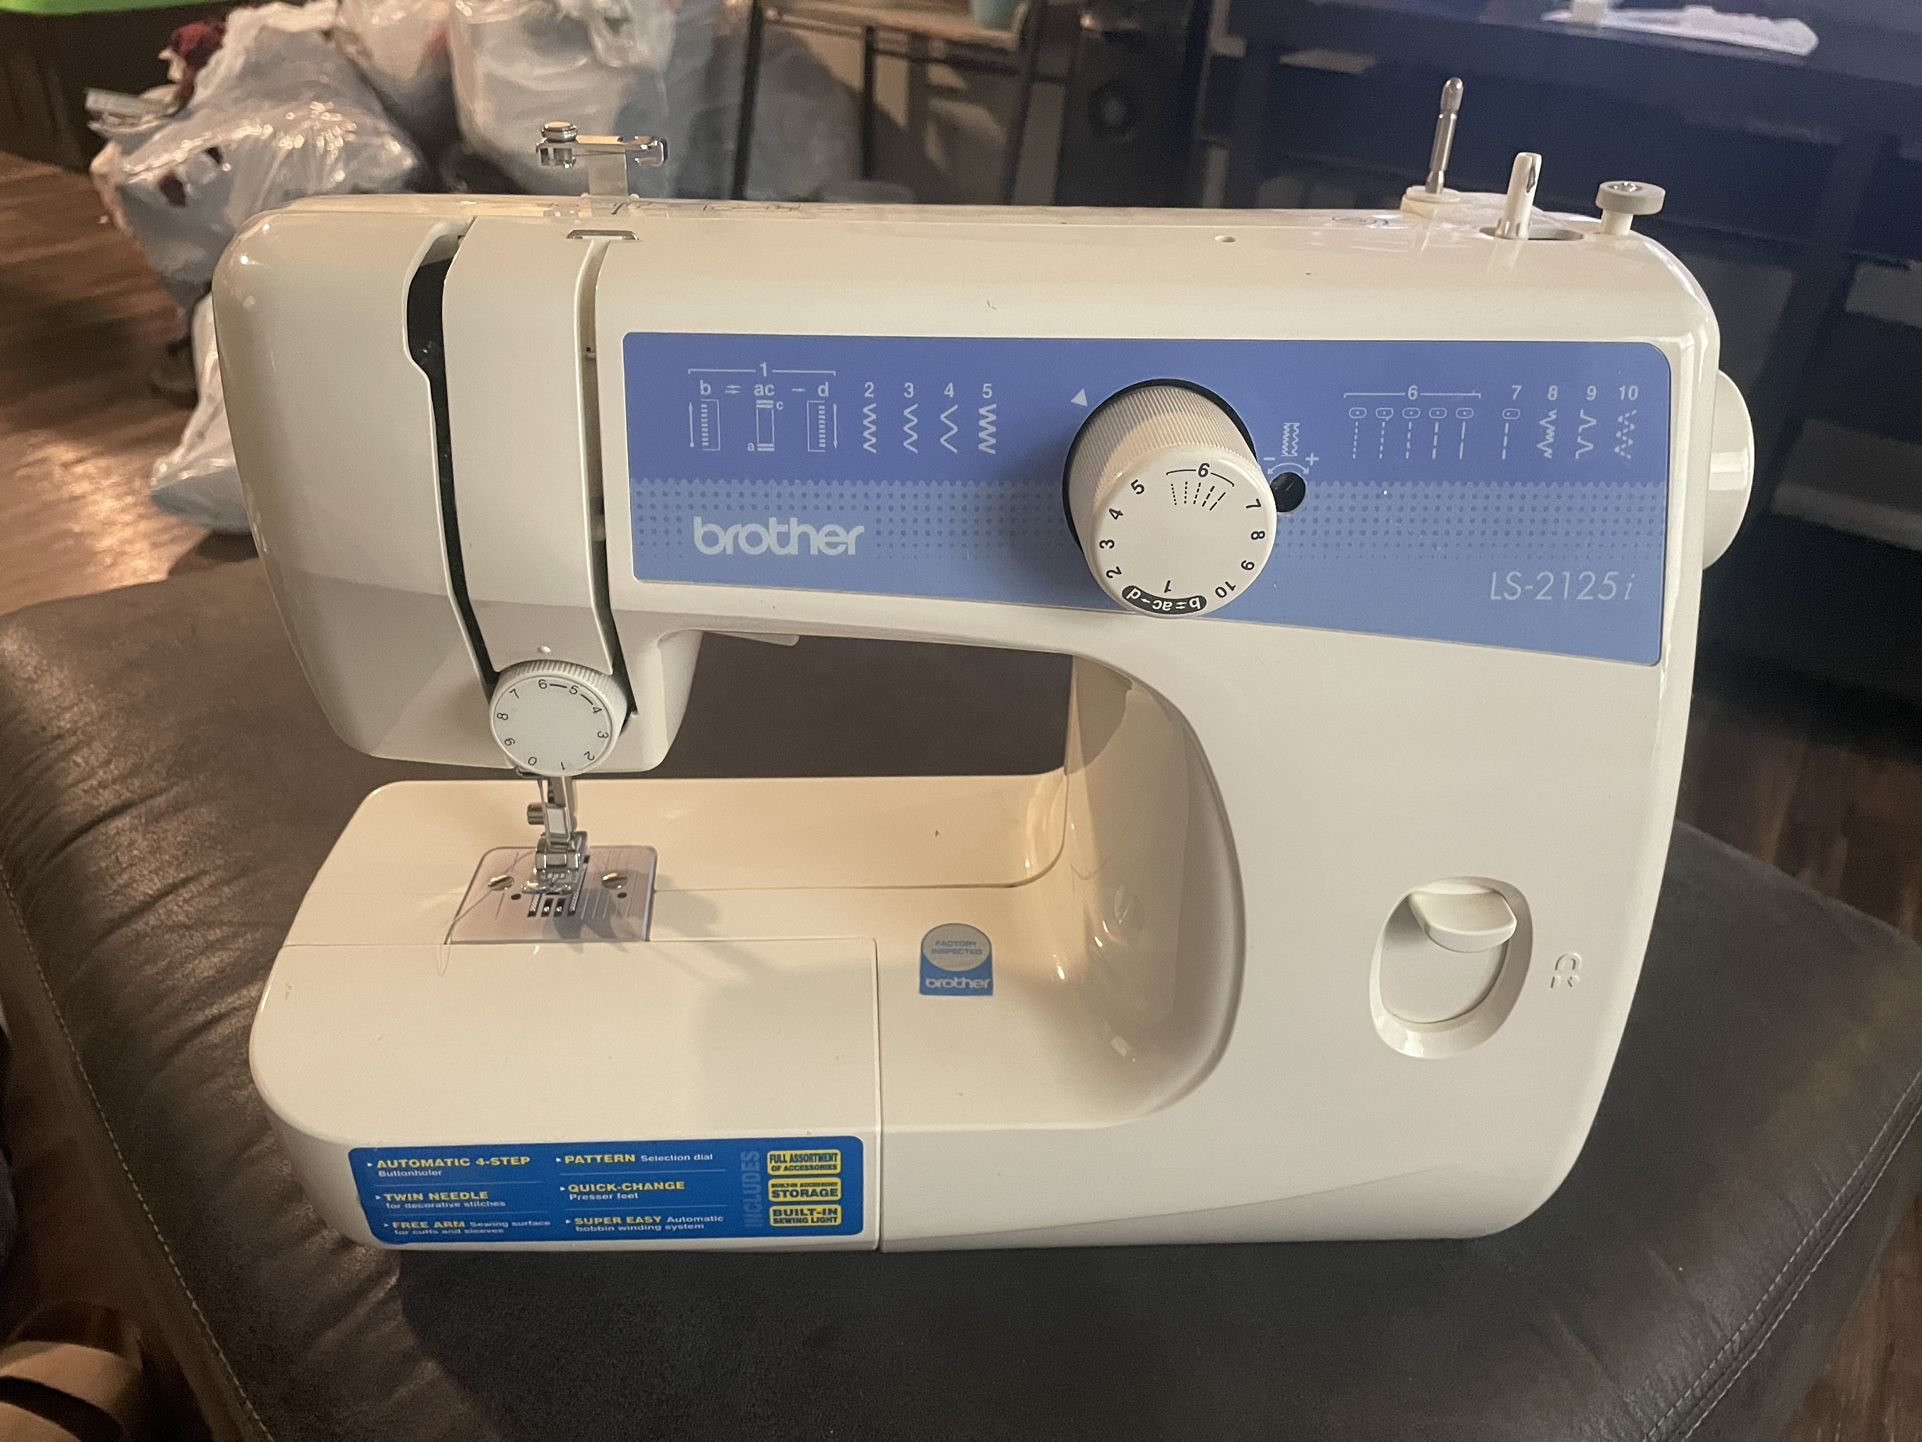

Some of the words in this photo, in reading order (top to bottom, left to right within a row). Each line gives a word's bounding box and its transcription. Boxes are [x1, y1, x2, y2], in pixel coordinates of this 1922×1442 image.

[759, 362, 768, 377] 1
[700, 380, 711, 396] b
[817, 381, 829, 397] d
[864, 382, 875, 398] 2
[904, 382, 914, 398] 3
[944, 383, 955, 398] 4
[982, 383, 993, 398] 5
[1407, 385, 1418, 400] 6
[1512, 385, 1522, 400] 7
[1547, 385, 1558, 400] 8
[1586, 386, 1597, 400] 9
[1619, 385, 1638, 401] 10
[1197, 462, 1210, 478] 6
[1130, 479, 1145, 496] 5
[1245, 498, 1262, 509] 7
[1108, 508, 1124, 521] 4
[693, 516, 864, 556] brother
[1250, 530, 1266, 541] 8
[1099, 539, 1115, 549] 3
[1106, 565, 1122, 579] 2
[1163, 580, 1171, 593] 1
[1215, 581, 1236, 598] 10
[538, 679, 548, 690] 6
[568, 684, 579, 695] 5
[509, 688, 520, 699] 7
[592, 706, 602, 715] 4
[496, 712, 509, 721] 8
[597, 730, 609, 739] 3
[527, 756, 538, 766] 0
[584, 751, 595, 761] 2
[560, 761, 566, 771] 1
[925, 976, 991, 989] brother
[377, 1158, 471, 1169] AUTOMATIC
[475, 1156, 531, 1166] 4-STEP
[564, 1154, 636, 1164] PATTERN
[640, 1154, 691, 1162] Selection
[693, 1153, 713, 1161] dial
[769, 1153, 787, 1164] FULL
[567, 1181, 686, 1193] QUICK-CHANGE
[384, 1193, 424, 1201] TWIN
[428, 1191, 489, 1201] NEEDLE
[569, 1193, 614, 1201] Presser
[617, 1192, 639, 1200] feet
[771, 1188, 839, 1198] STORAGE
[404, 1201, 461, 1209] decorative
[463, 1200, 506, 1208] stitches
[772, 1208, 838, 1217] BUILT-IN
[391, 1221, 429, 1229] FREE
[434, 1221, 465, 1229] ARM
[574, 1216, 622, 1225] SUPER
[626, 1215, 662, 1224] EASY
[666, 1215, 724, 1223] Automatic
[575, 1224, 615, 1232] bobbin
[618, 1223, 662, 1232] winding
[664, 1223, 705, 1231] system
